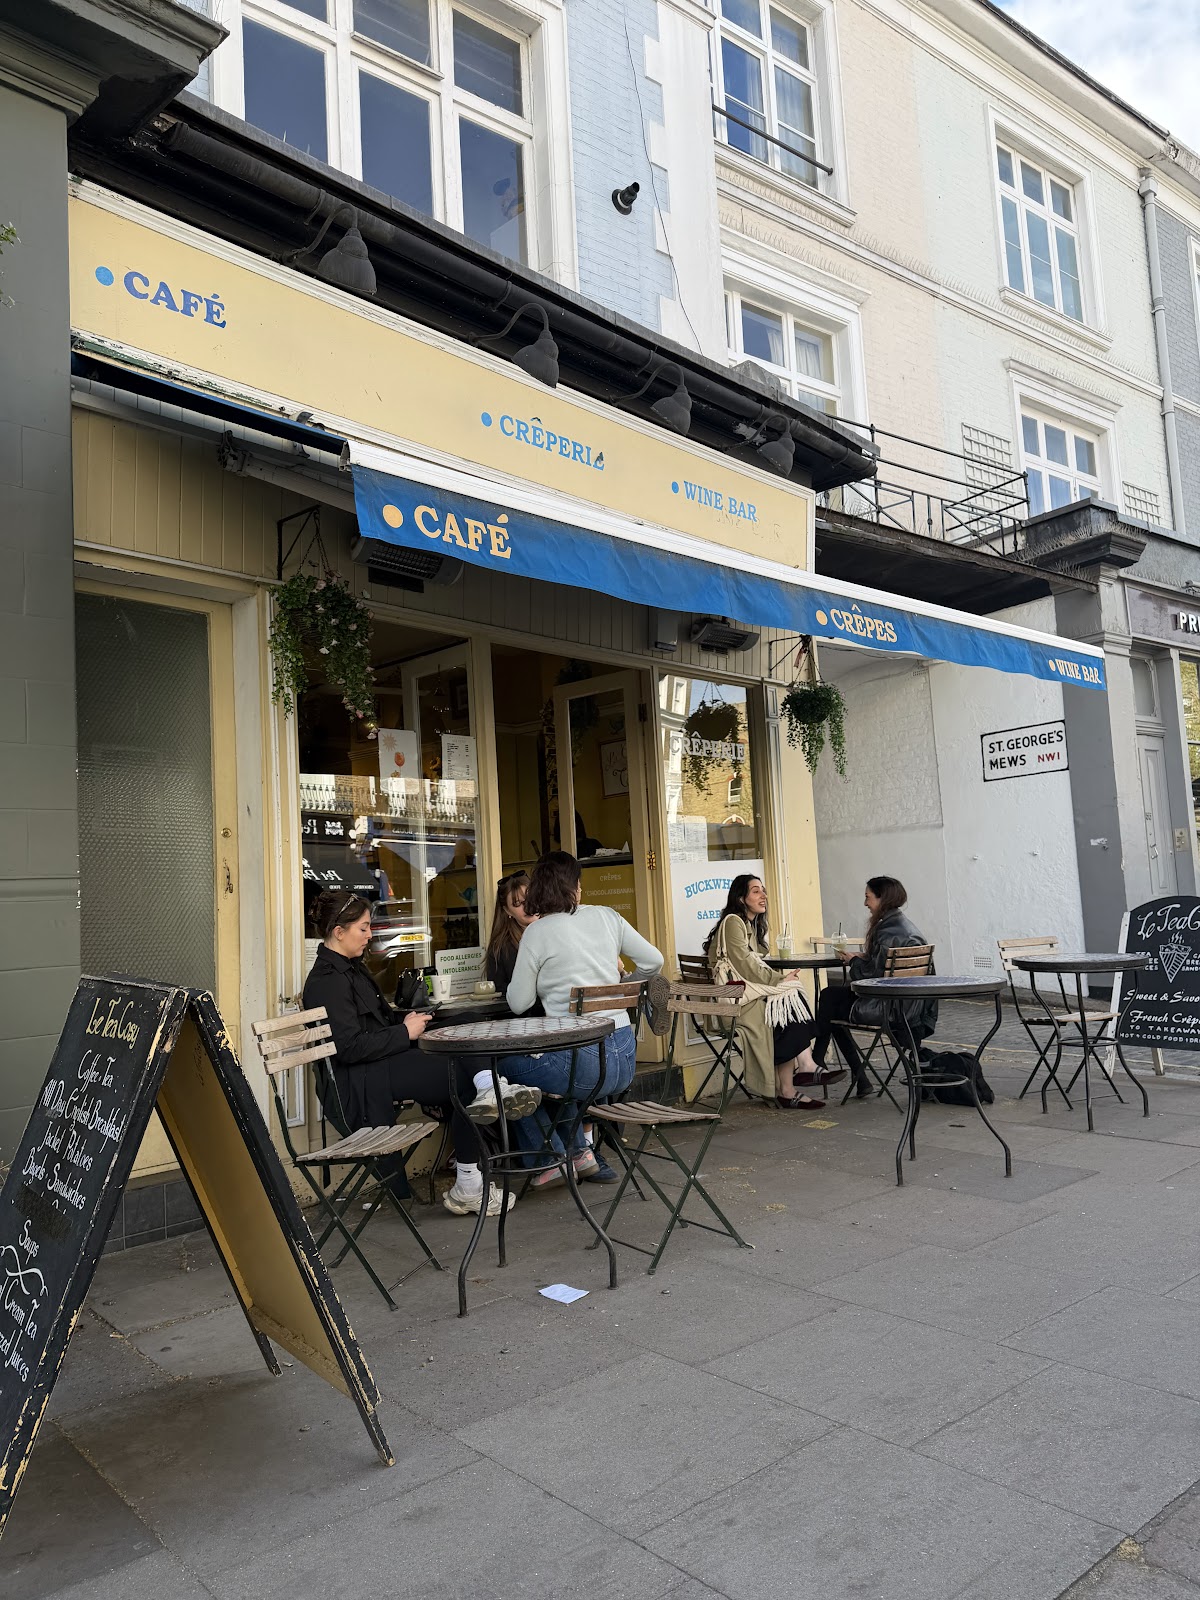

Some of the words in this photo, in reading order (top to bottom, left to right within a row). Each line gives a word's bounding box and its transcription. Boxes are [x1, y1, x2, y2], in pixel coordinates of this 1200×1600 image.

[124, 271, 227, 329] CAFÉ
[683, 480, 724, 511] WINE
[728, 496, 758, 522] BAR
[413, 504, 512, 559] CAFÉ
[830, 603, 898, 643] CRÊPES
[1055, 658, 1082, 680] WINE
[1081, 665, 1102, 684] BAR
[670, 731, 744, 760] CRÊPERIE
[988, 740, 1005, 754] ST.
[1006, 730, 1063, 750] GEORGE'S
[989, 754, 1027, 770] MEWS
[684, 878, 734, 898] BUCKWH
[443, 965, 480, 974] INTOLERANCES
[1123, 989, 1158, 1001] Sweet
[1160, 993, 1169, 1001] &
[1129, 1010, 1168, 1023] French
[78, 1050, 101, 1093] Coffee
[102, 1057, 116, 1087] Tea
[39, 1079, 58, 1109] All
[50, 1080, 66, 1117] Day
[65, 1088, 94, 1131] English
[88, 1100, 126, 1153] Breakfast
[37, 1121, 66, 1154] Jacket
[62, 1129, 93, 1171] Potatoes
[47, 1163, 86, 1211] Sandwiches
[18, 1219, 40, 1264] Soups
[5, 1279, 25, 1326] Cream
[25, 1299, 40, 1340] Tea
